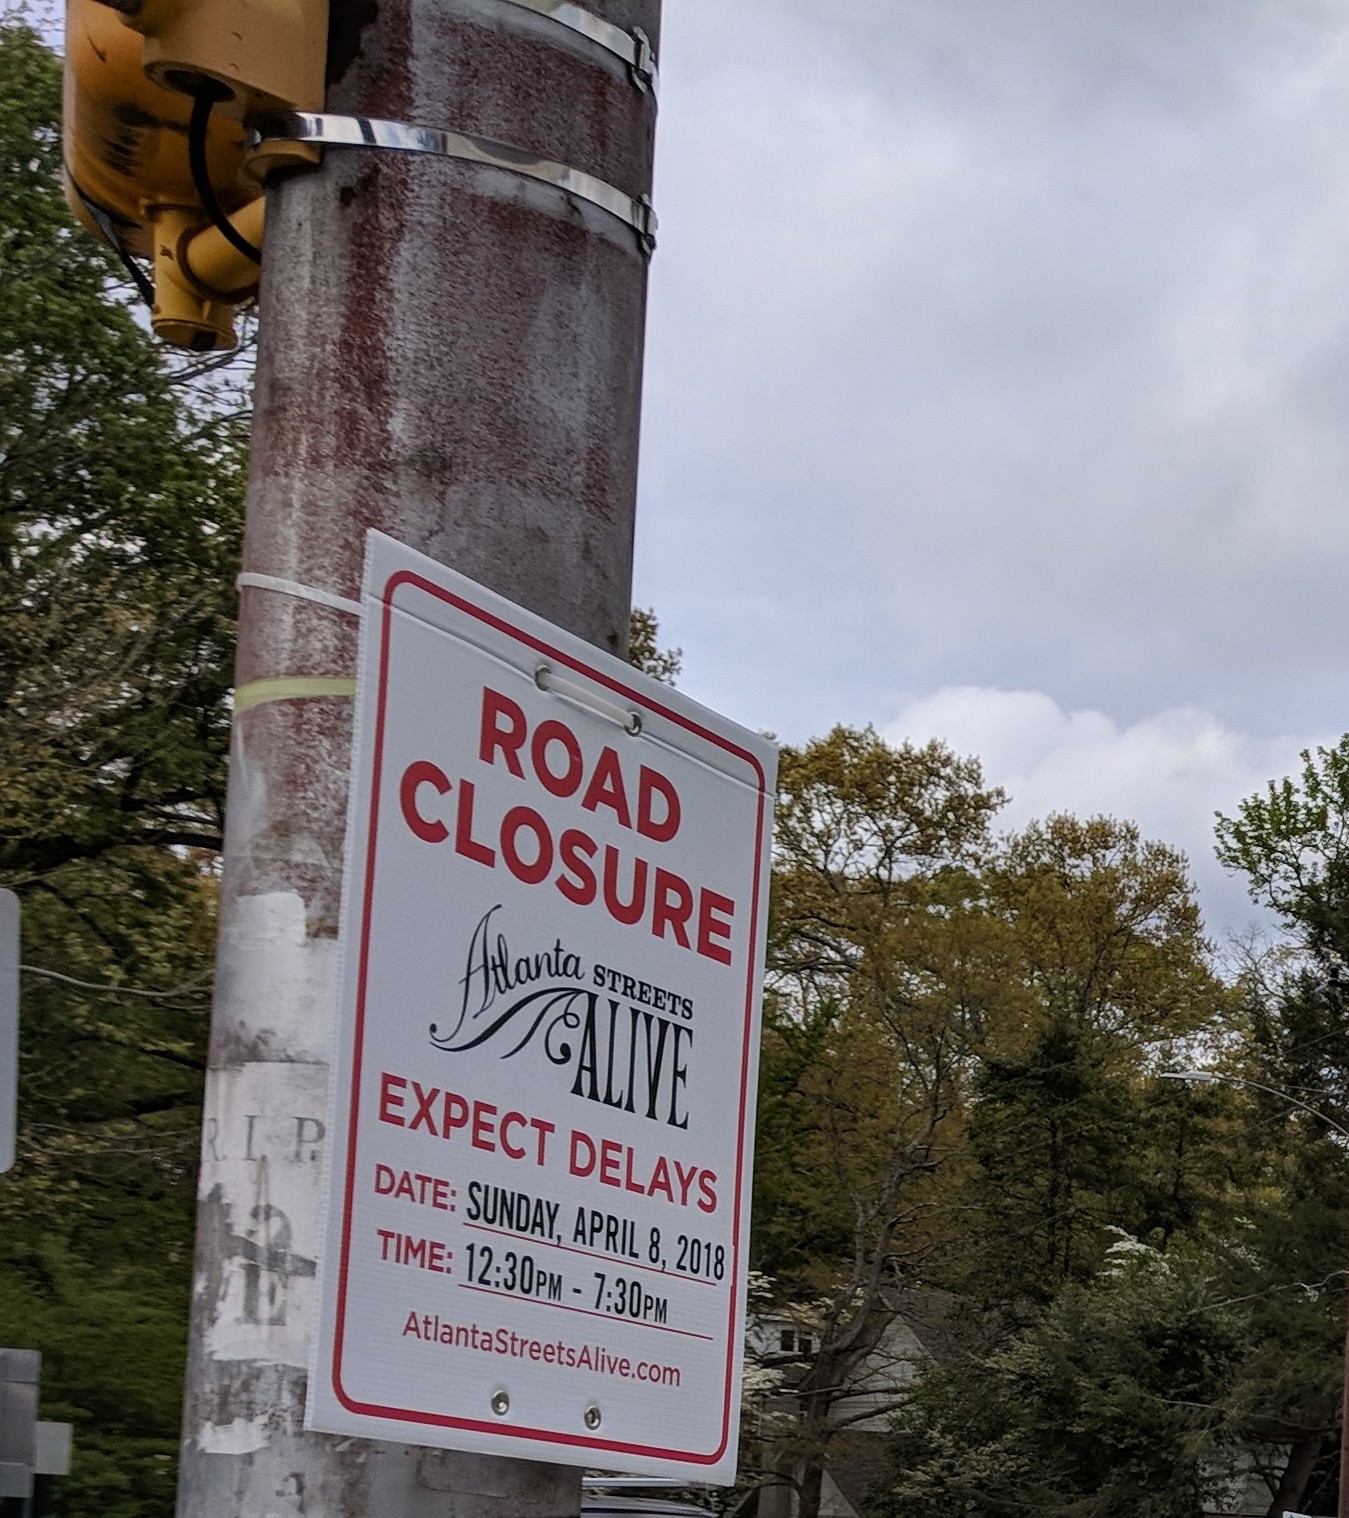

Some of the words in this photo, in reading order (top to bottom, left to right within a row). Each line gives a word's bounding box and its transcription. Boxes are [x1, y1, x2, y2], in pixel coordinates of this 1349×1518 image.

[479, 686, 682, 843] ROAD
[400, 759, 736, 967] CLOSURE
[429, 903, 586, 1043] Atlanta
[592, 963, 694, 1021] STREETS
[570, 990, 694, 1131] ALIVE
[377, 1072, 557, 1167] EXPECT
[568, 1129, 719, 1214] DELAYS
[374, 1162, 457, 1212] DATE:
[466, 1180, 563, 1247] SUNDAY,
[571, 1206, 640, 1260] APRIL
[648, 1226, 667, 1272] 8,
[675, 1234, 726, 1282] 2018
[375, 1228, 454, 1275] TIME:
[465, 1242, 564, 1302] 12:30PM
[592, 1271, 669, 1325] 7:30PM
[402, 1312, 682, 1388] AtlantaStreetsAlive.com
